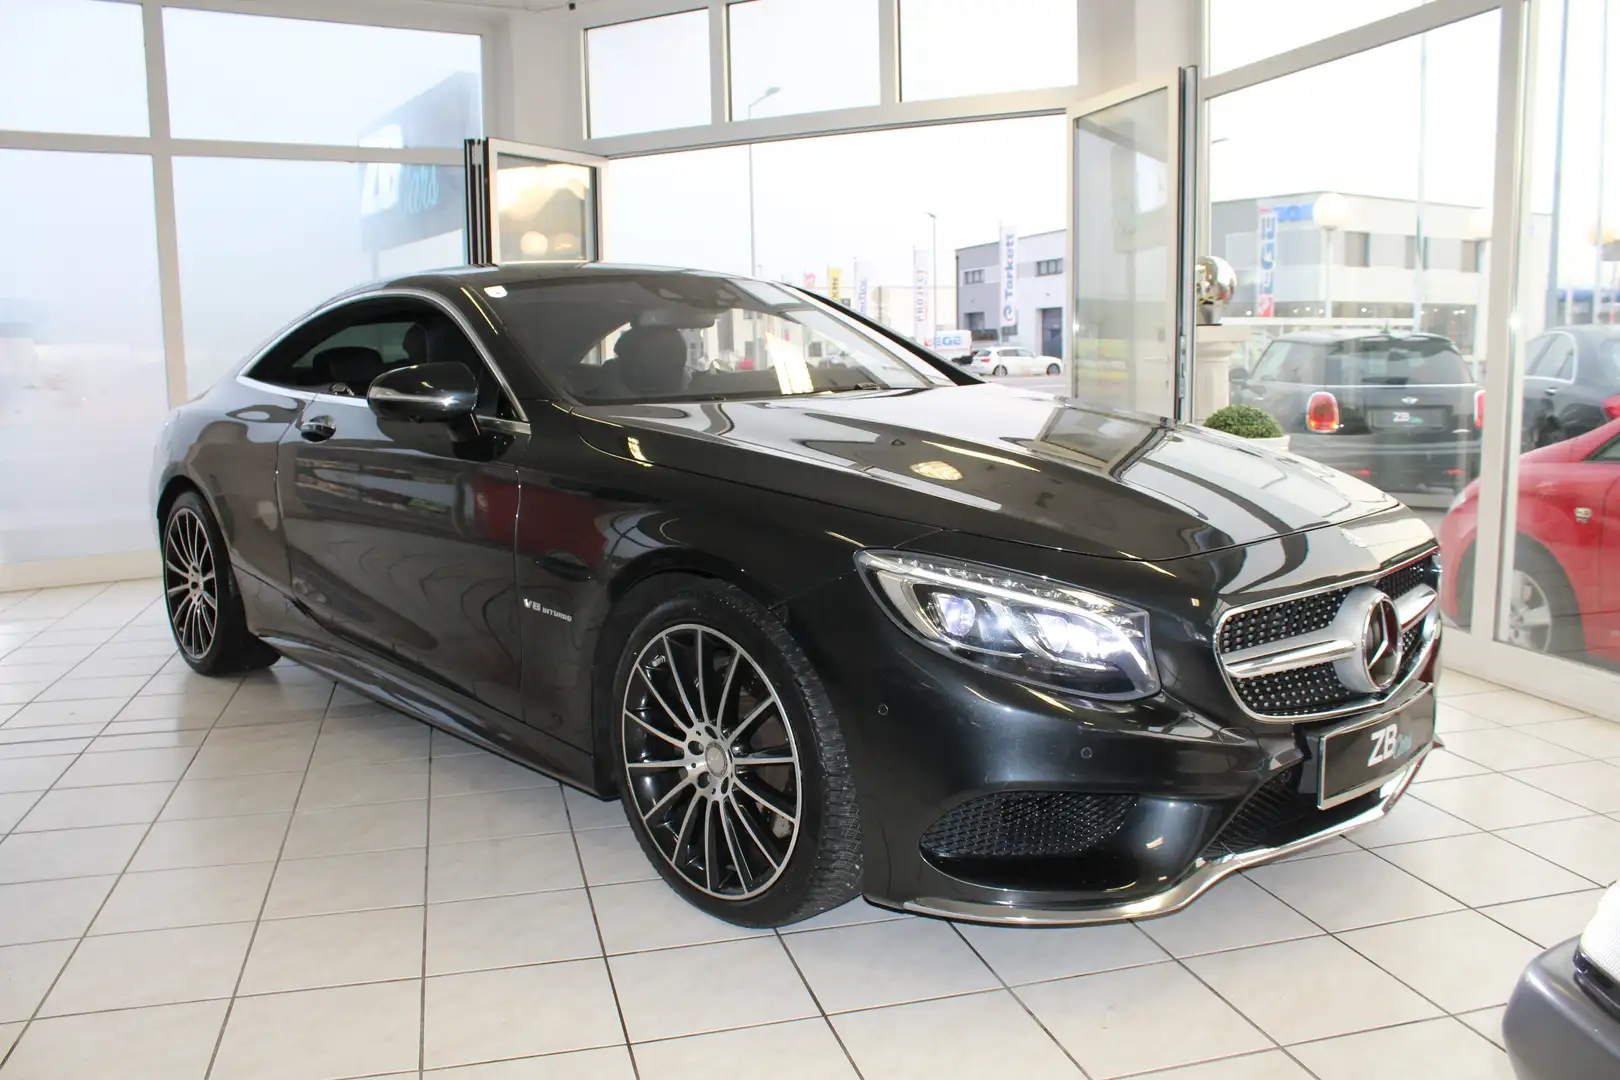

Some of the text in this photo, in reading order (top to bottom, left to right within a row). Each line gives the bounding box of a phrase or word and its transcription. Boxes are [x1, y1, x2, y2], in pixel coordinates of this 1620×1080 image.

[1004, 233, 1015, 300] Tarkett
[523, 598, 573, 622] V8 BITURBO
[1367, 723, 1398, 767] ZB
